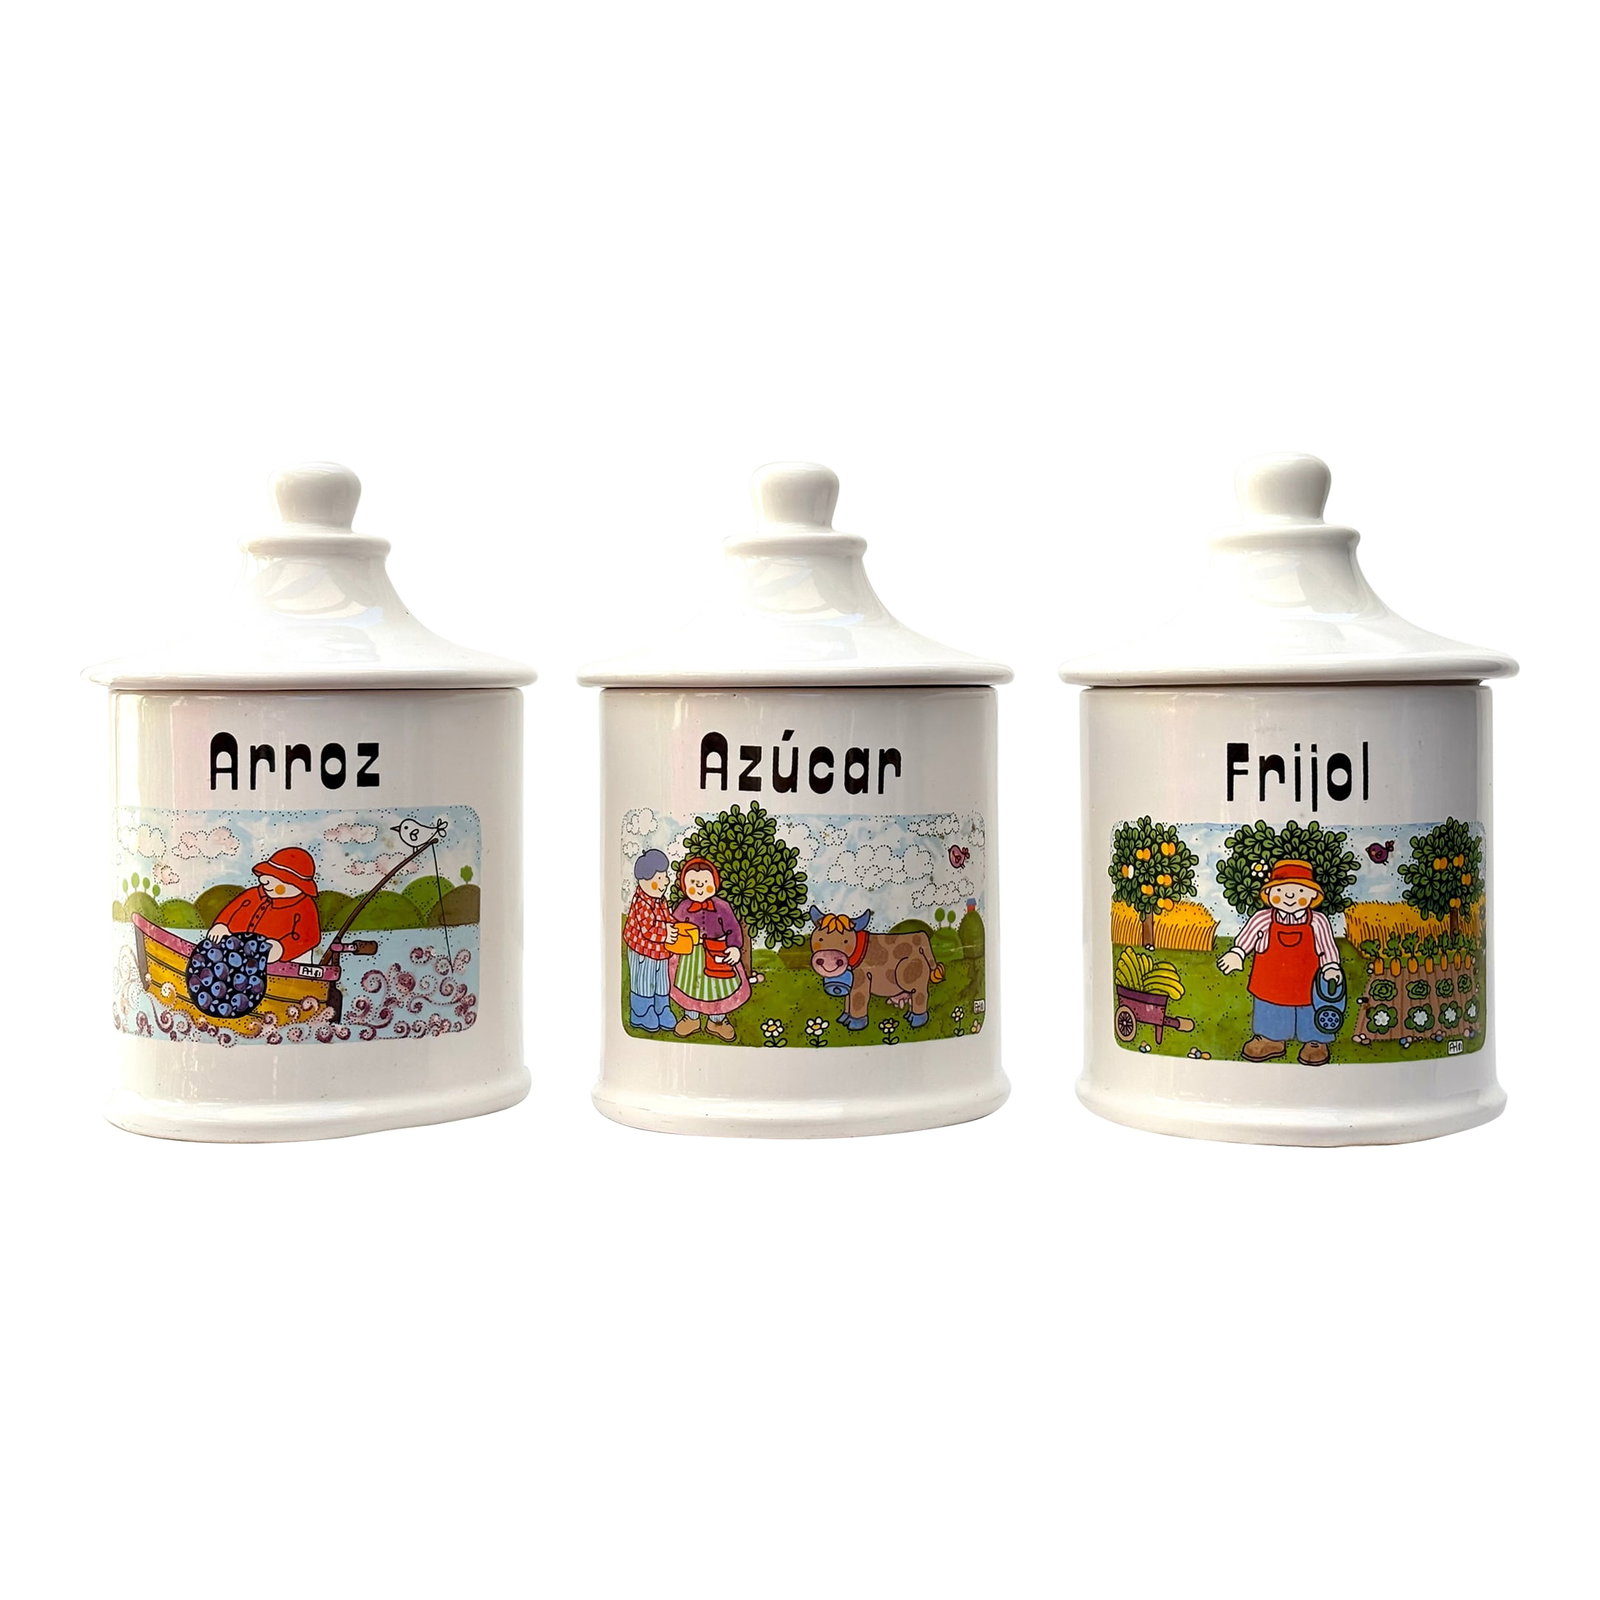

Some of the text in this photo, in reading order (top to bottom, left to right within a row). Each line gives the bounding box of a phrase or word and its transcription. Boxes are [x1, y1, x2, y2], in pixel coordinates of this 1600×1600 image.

[209, 731, 380, 791] Arroz
[699, 729, 903, 796] Azúcar
[1226, 741, 1370, 813] Frijol
